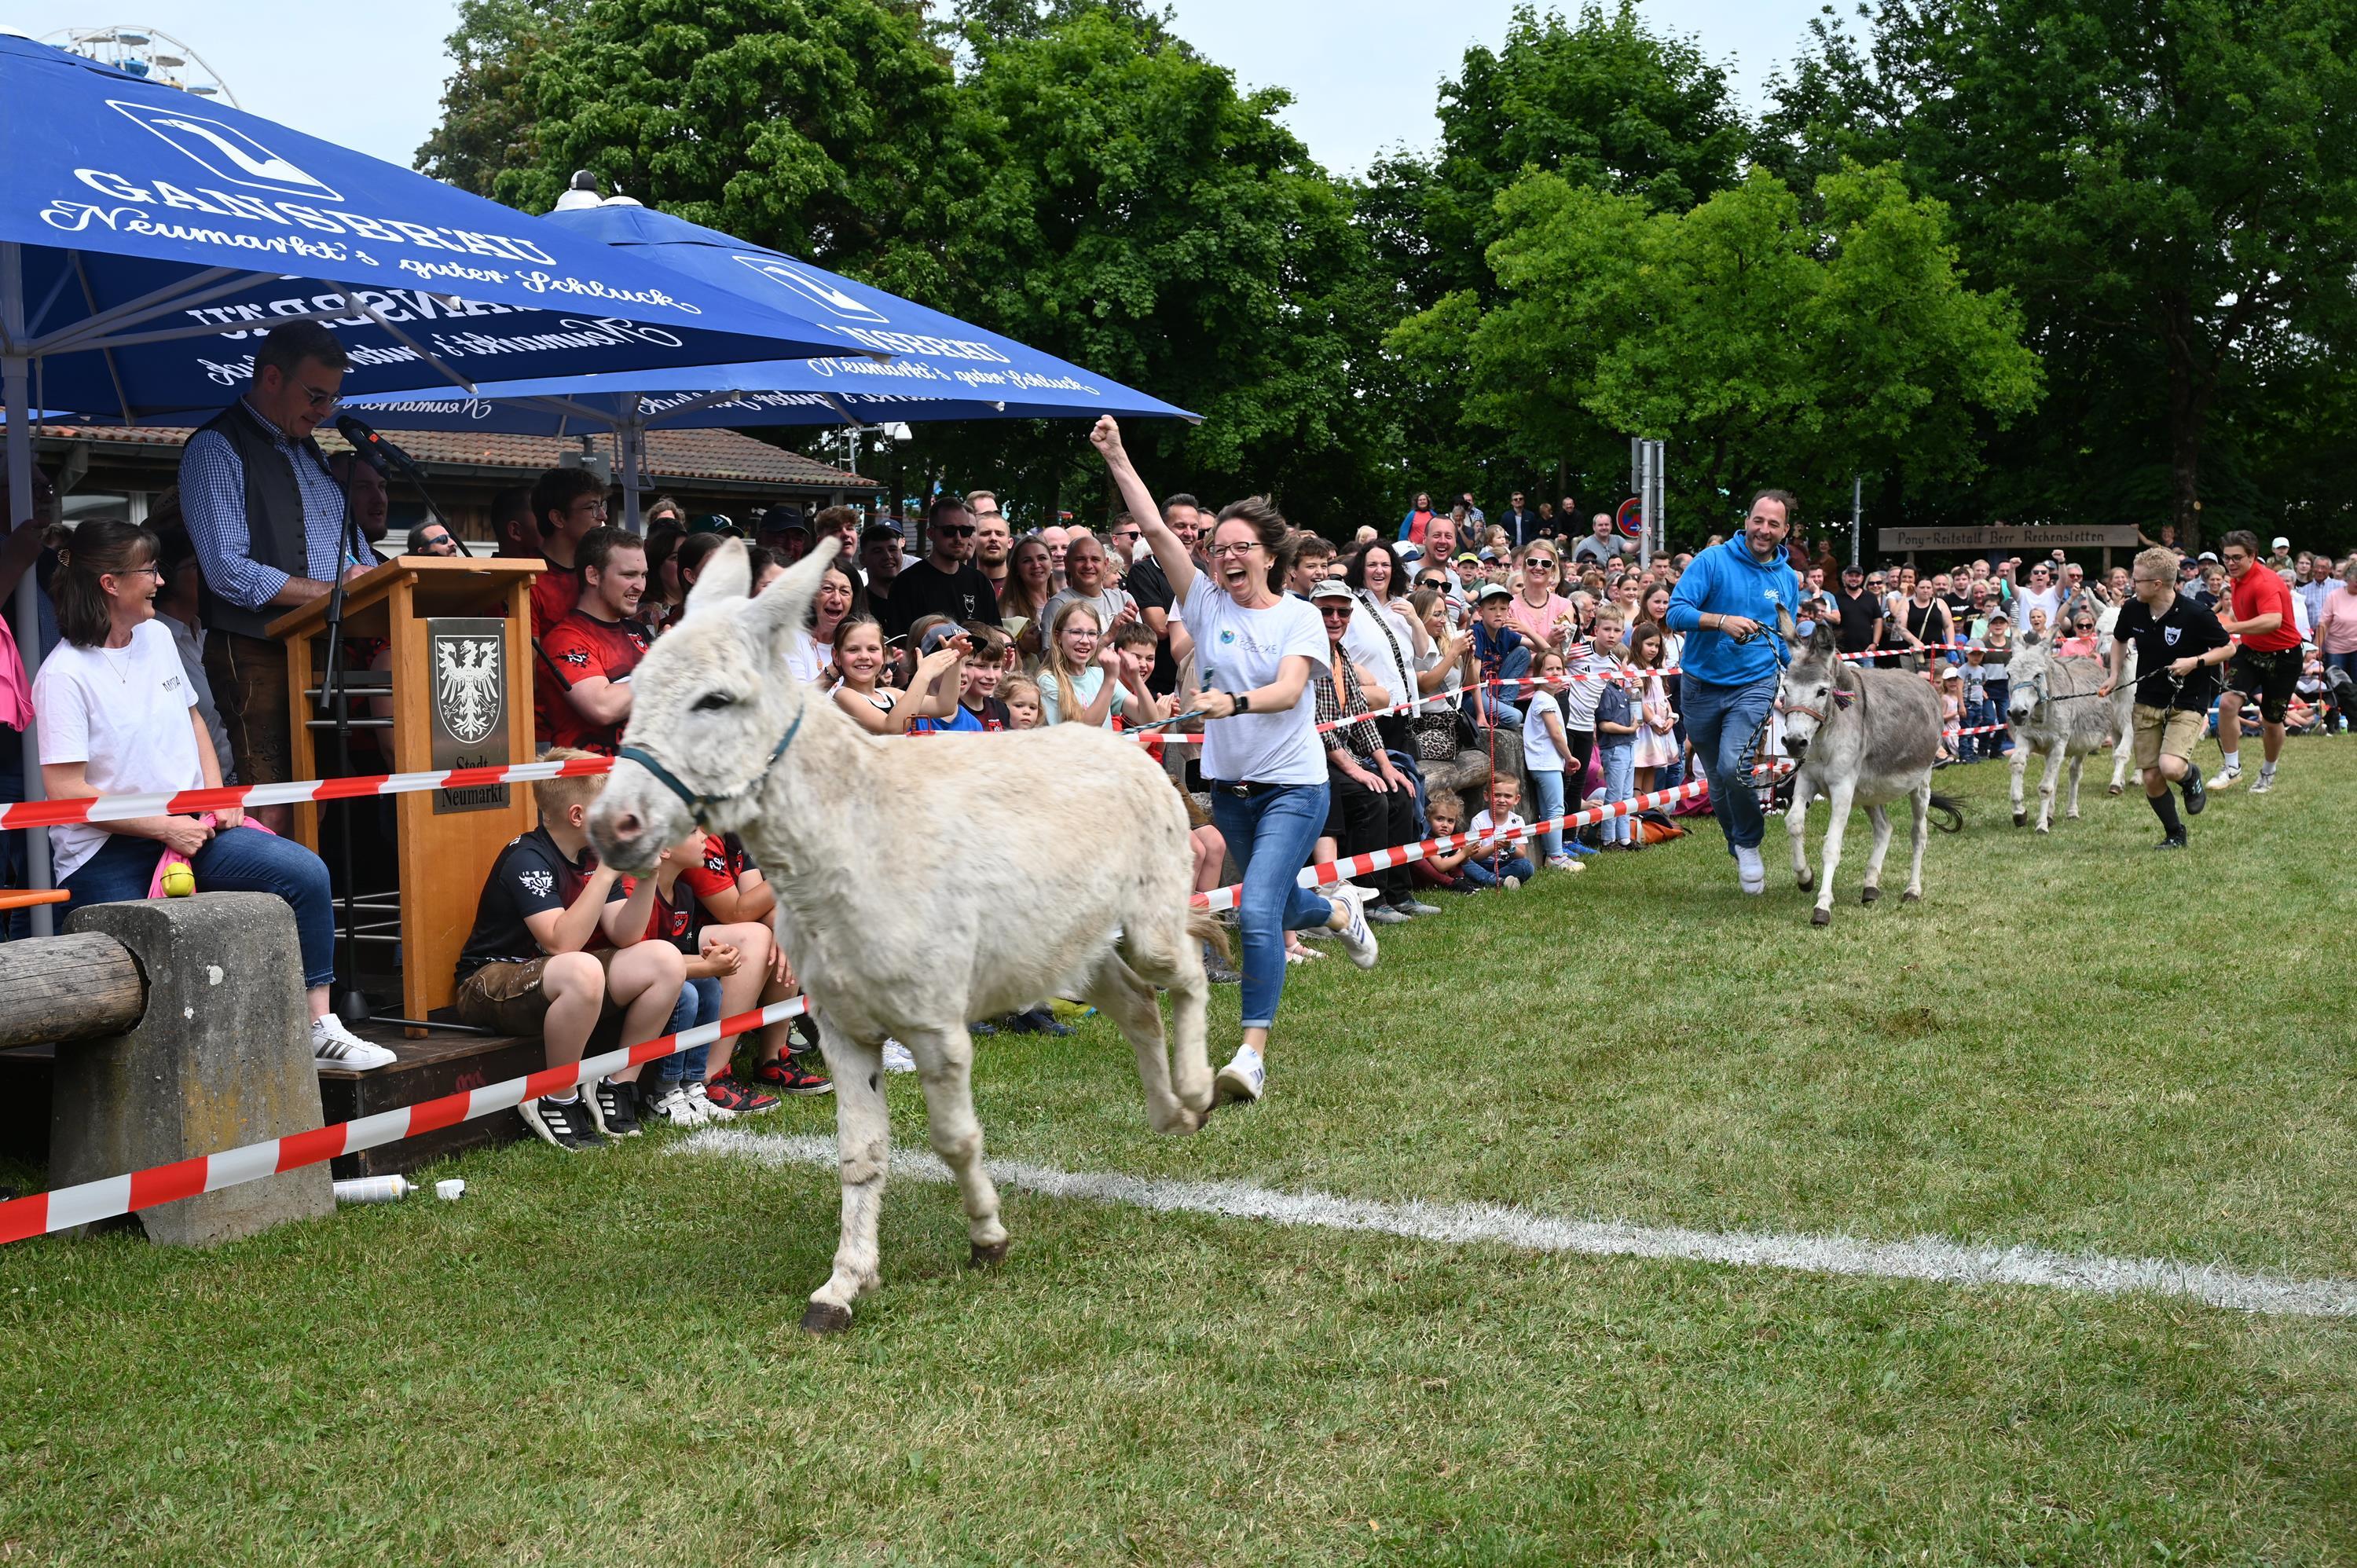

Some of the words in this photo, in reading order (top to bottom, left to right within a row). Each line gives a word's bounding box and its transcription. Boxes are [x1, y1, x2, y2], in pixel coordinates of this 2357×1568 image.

[74, 169, 556, 266] GANSBRÄU
[399, 258, 509, 284] guter
[515, 270, 702, 315] Schluck
[816, 324, 1011, 364] NSBRÄU
[955, 368, 1005, 389] guter
[1003, 370, 1100, 395] Schluck
[1364, 602, 1390, 635] GEORGE
[1387, 633, 1401, 656] GINA
[442, 784, 503, 807] Neumarkt
[529, 877, 548, 888] ASV
